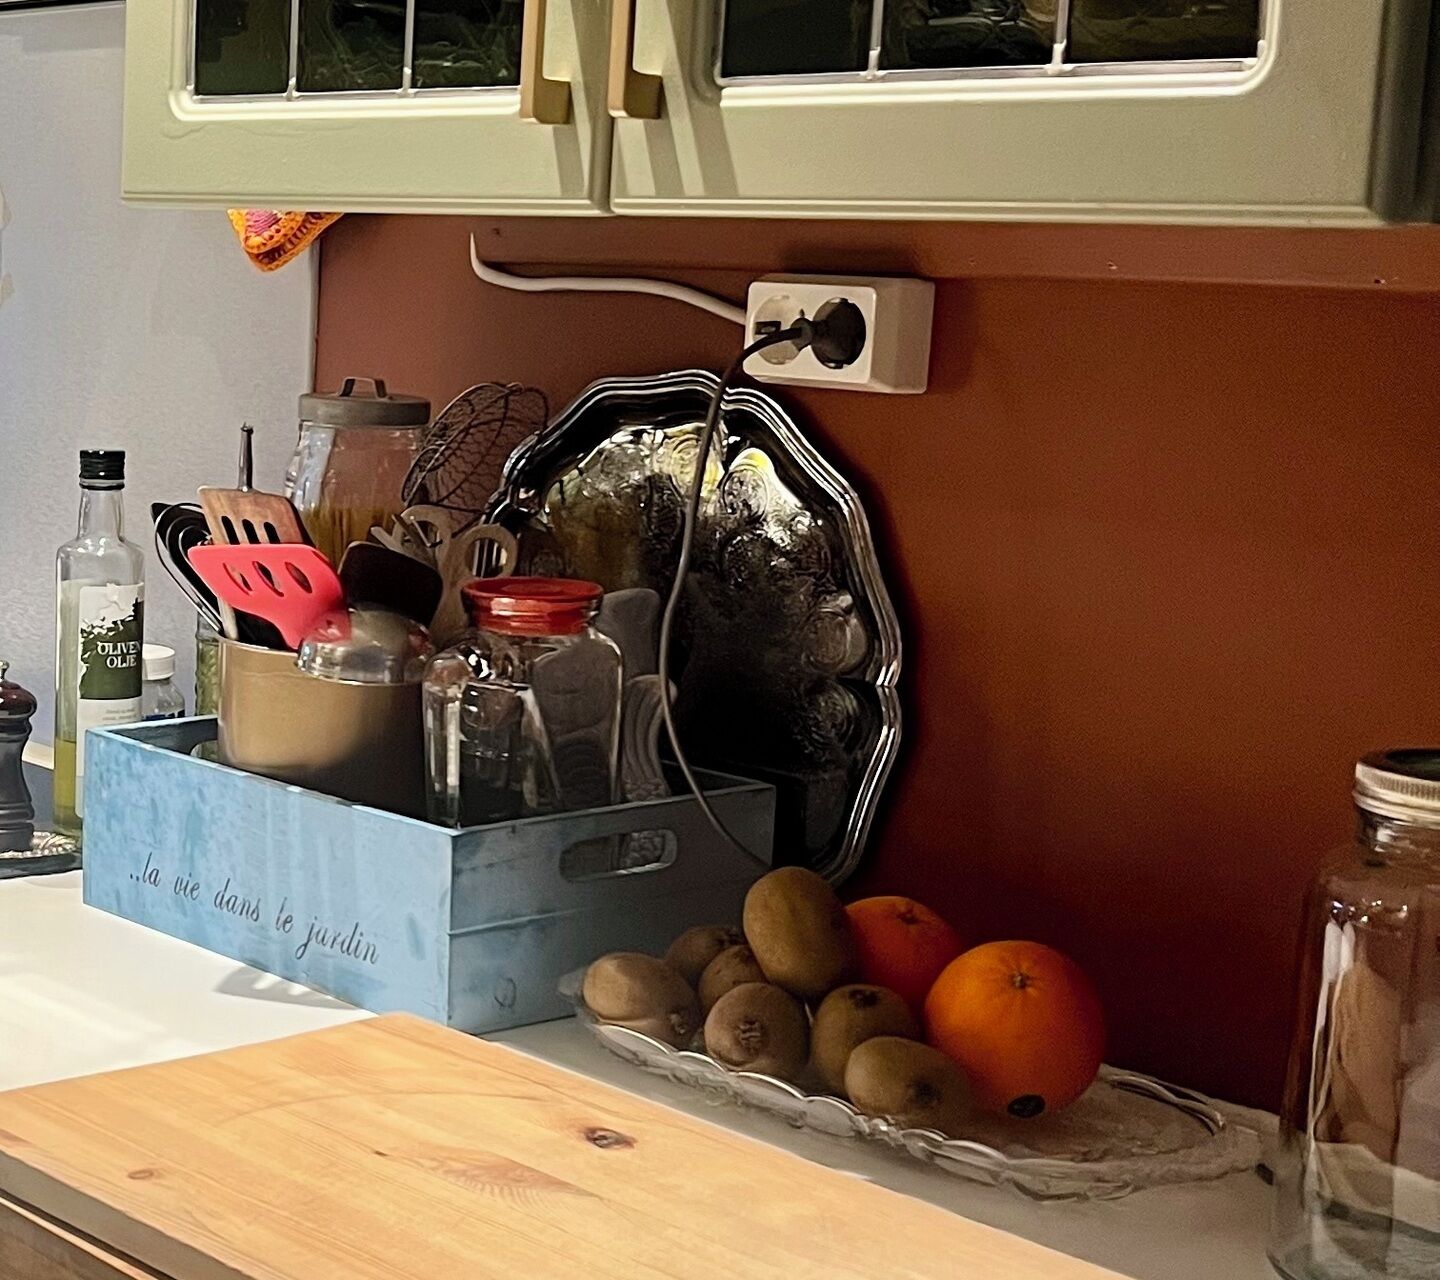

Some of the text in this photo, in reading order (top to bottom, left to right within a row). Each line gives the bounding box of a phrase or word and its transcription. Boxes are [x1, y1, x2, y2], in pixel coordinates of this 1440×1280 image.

[106, 654, 137, 669] OLJE
[172, 871, 200, 902] vie
[213, 877, 261, 923] dans
[274, 897, 295, 934] le
[294, 918, 381, 964] jardin
